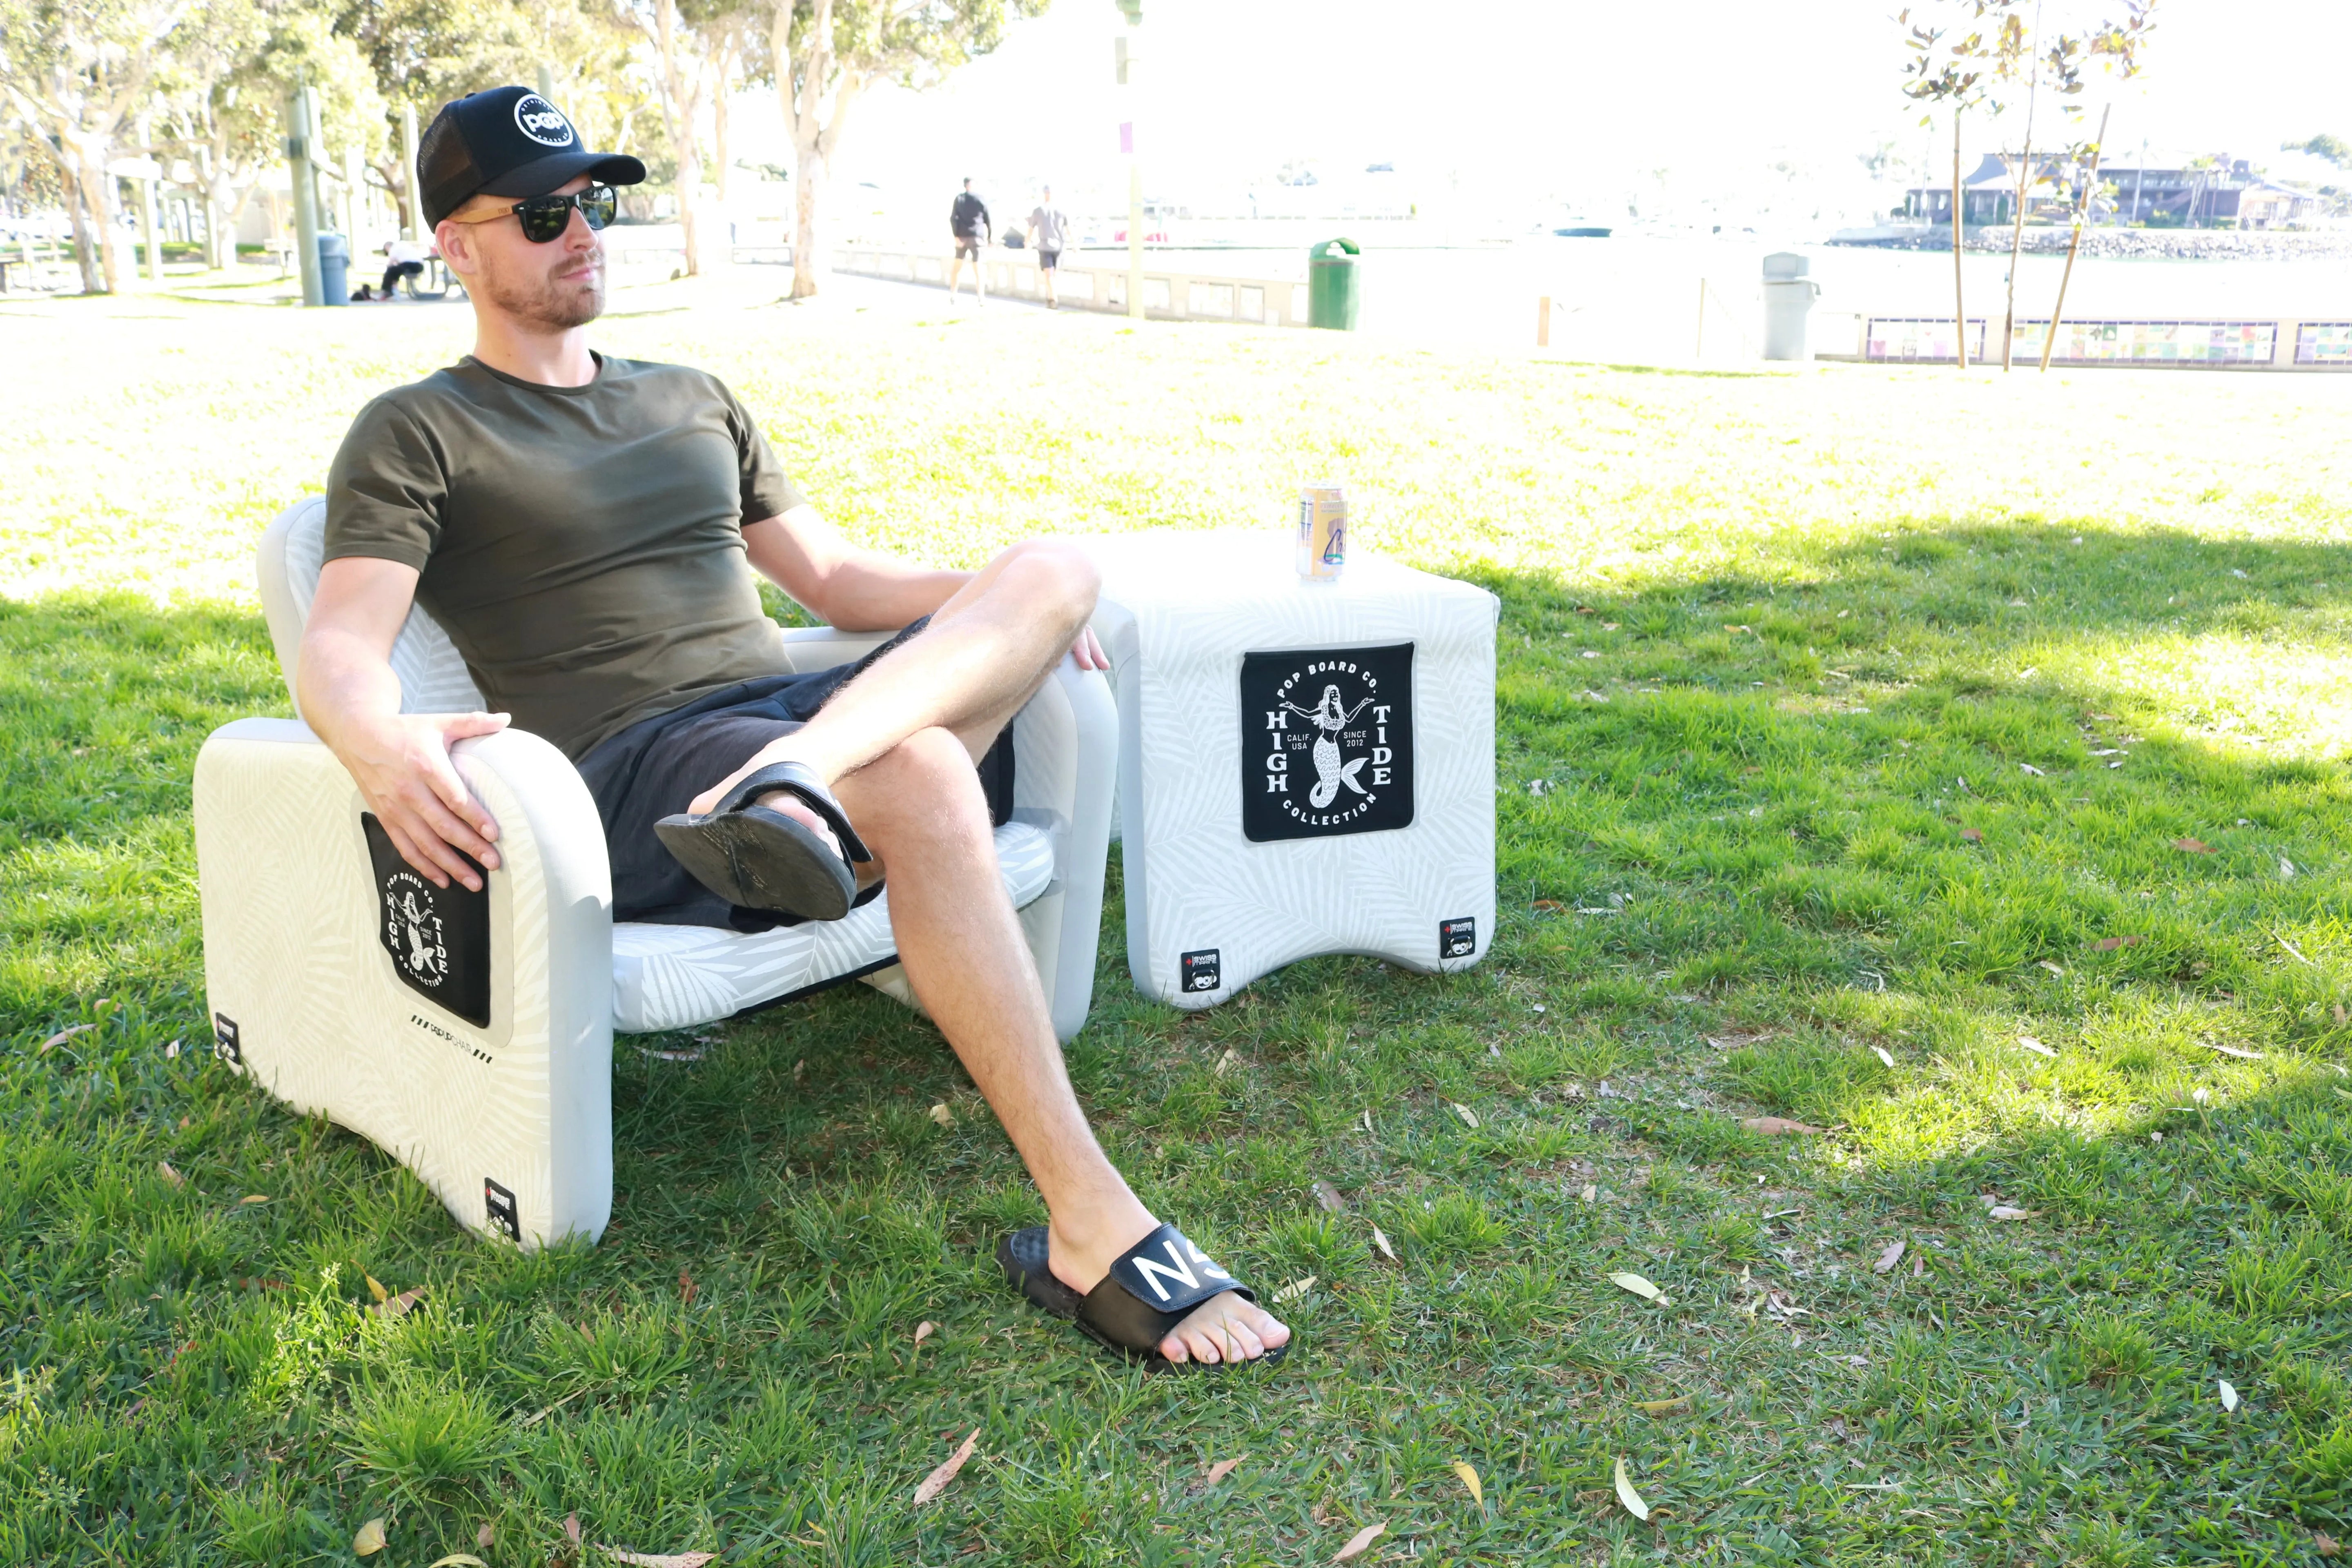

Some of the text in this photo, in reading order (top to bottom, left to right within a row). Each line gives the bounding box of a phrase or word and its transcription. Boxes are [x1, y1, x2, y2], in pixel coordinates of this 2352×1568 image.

[1277, 661, 1377, 698] POP BOARD CO.
[1266, 711, 1288, 793] HIGH
[1287, 734, 1312, 742] CALIF.
[1343, 731, 1367, 739] SINCE
[1346, 739, 1363, 747] 2012
[1371, 705, 1392, 785] TIDE
[1283, 793, 1376, 825] COLLECTION
[387, 872, 434, 908] POP BOARD CO.
[386, 892, 401, 950] HIGH
[1452, 921, 1472, 929] SWISS
[432, 916, 448, 974] TIDE
[399, 955, 443, 987] COLLECTION
